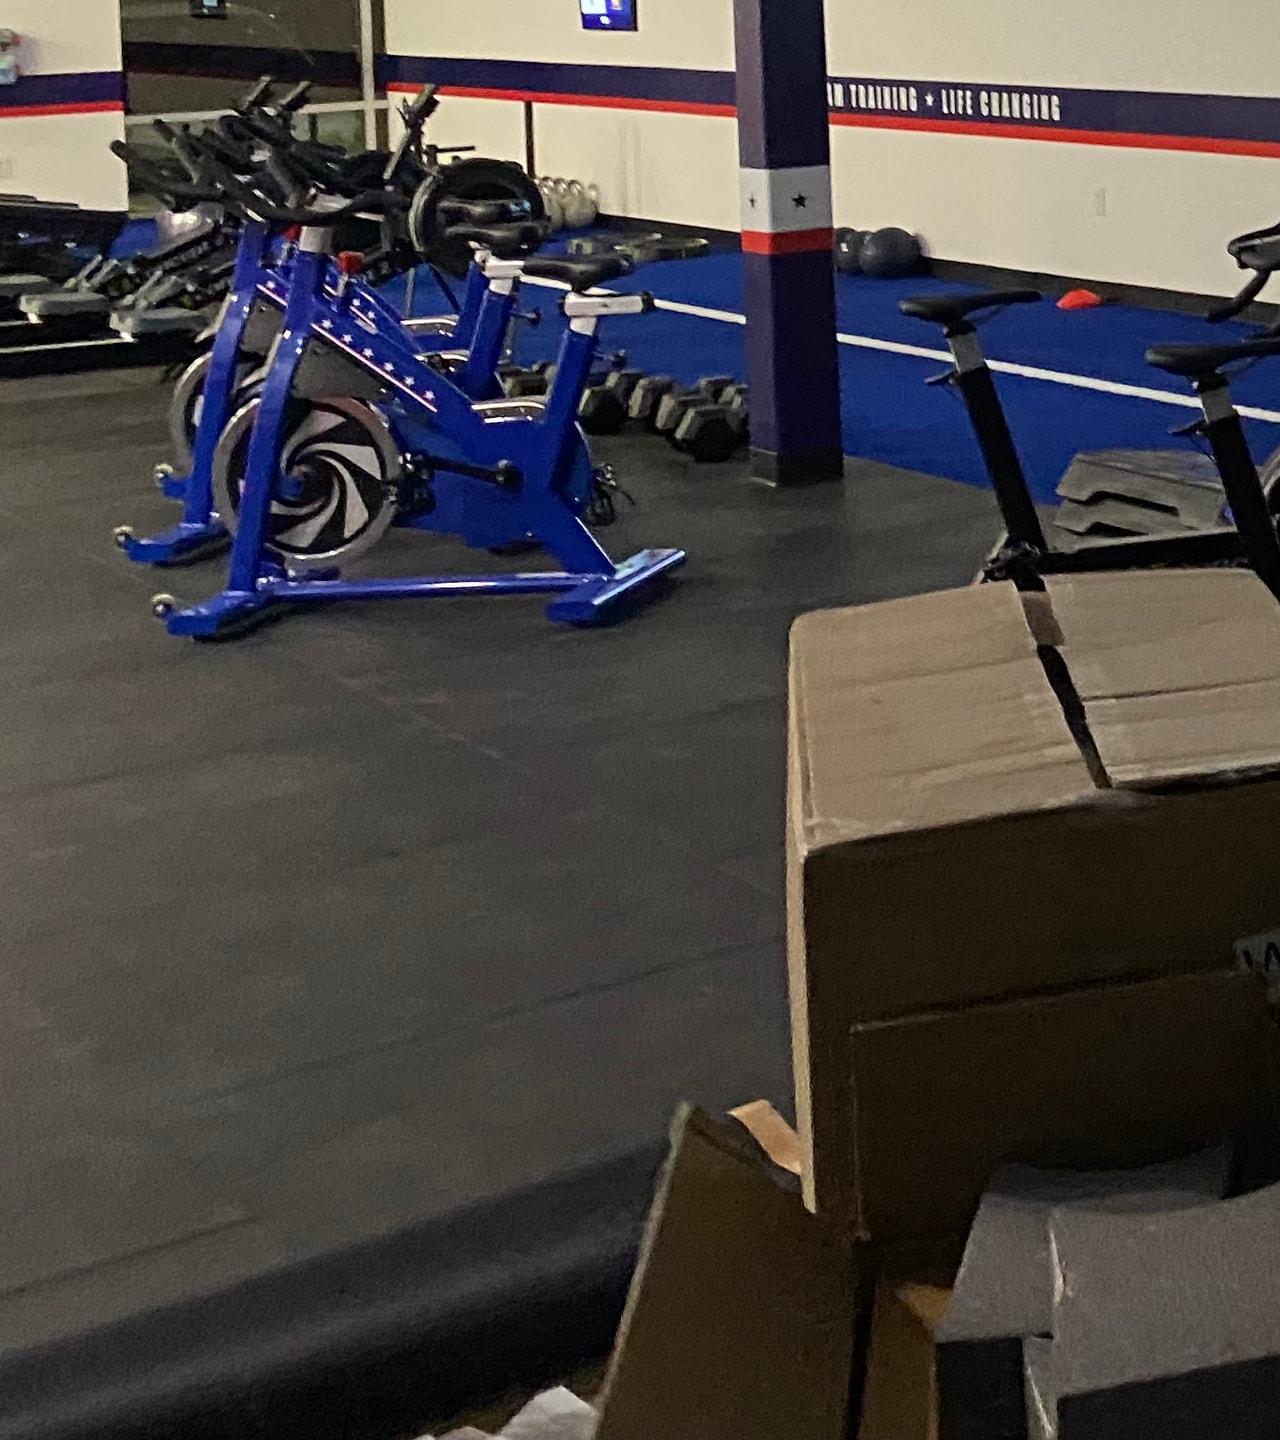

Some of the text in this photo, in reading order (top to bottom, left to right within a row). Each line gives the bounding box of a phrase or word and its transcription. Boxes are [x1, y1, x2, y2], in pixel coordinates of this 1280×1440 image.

[848, 83, 918, 112] TRAINING
[941, 88, 973, 115] LIFE
[979, 90, 1062, 121] CHANGING
